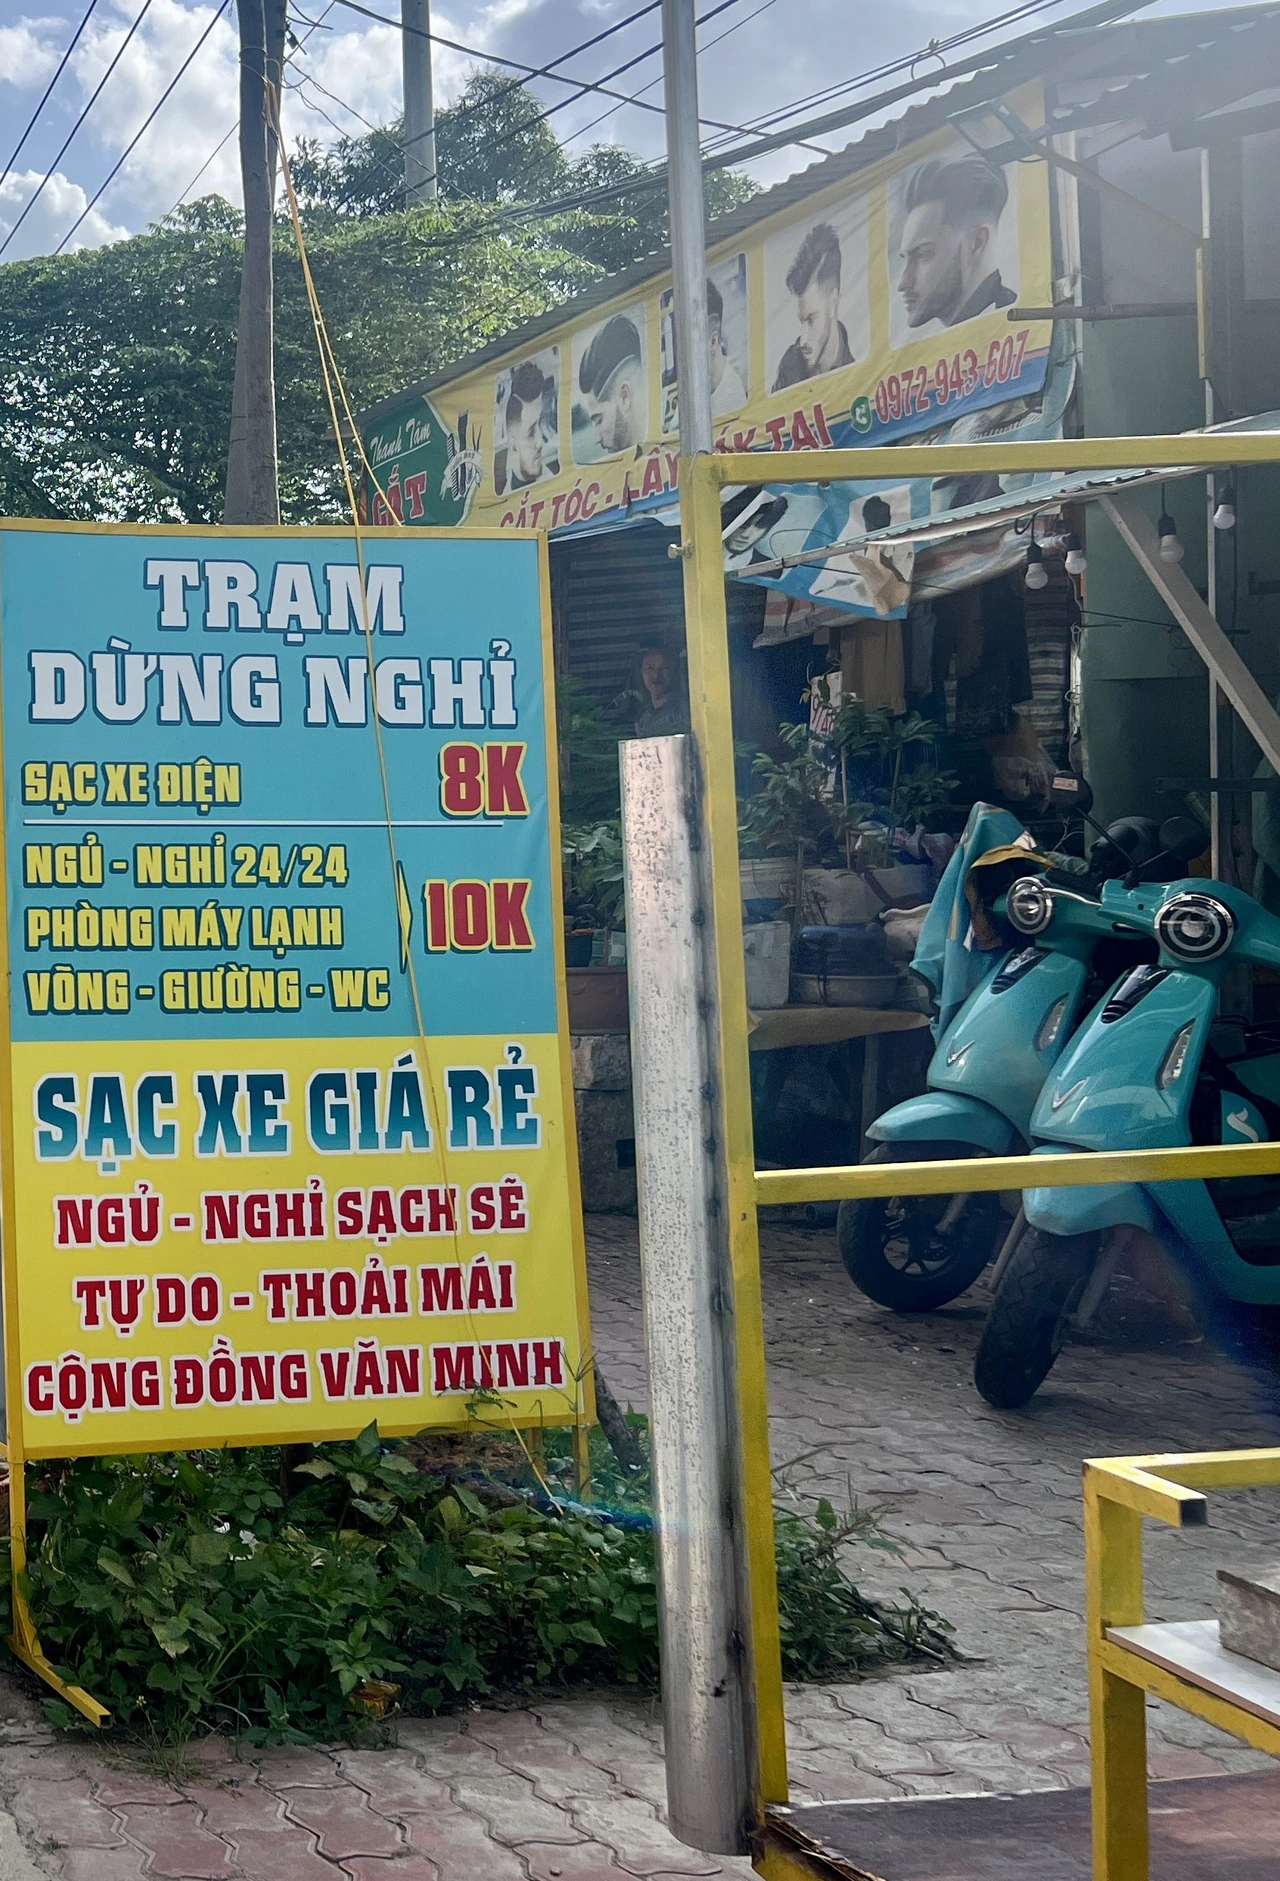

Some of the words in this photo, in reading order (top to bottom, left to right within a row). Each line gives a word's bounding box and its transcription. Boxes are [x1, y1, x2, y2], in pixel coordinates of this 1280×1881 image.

[875, 365, 930, 424] 0972
[934, 348, 978, 405] 943
[983, 328, 1030, 388] 607
[370, 426, 402, 467] Thanh
[405, 417, 431, 449] Tâm
[551, 478, 600, 528] TÓC
[765, 403, 833, 451] TAI
[145, 558, 406, 644] TRẠM
[28, 637, 283, 726] DỪNG
[304, 639, 519, 727] NGHỈ
[22, 760, 99, 814] SẠC
[102, 761, 148, 804] XE
[157, 756, 242, 814] ĐIỆN
[439, 741, 530, 817] 8K
[23, 834, 104, 887] NGỦ
[134, 834, 227, 887] NGHỈ
[232, 843, 349, 886] 24/24
[25, 901, 154, 951] PHÒNG
[160, 900, 245, 950] MÁY
[251, 906, 345, 957] LẠNH
[424, 879, 536, 954] 10K
[25, 965, 130, 1014] VÕNG
[163, 967, 302, 1013] GIƯỜNG
[330, 968, 390, 1011] WC
[34, 1070, 179, 1175] SẠC
[194, 1068, 291, 1157] XE
[306, 1049, 433, 1155] GIÁ
[444, 1042, 541, 1151] RẺ
[54, 1179, 160, 1249] NGỦ
[202, 1175, 327, 1243] NGHỈ
[337, 1184, 458, 1246] SẠCH
[467, 1176, 529, 1234] SẼ
[74, 1275, 147, 1337] TỰ
[153, 1271, 221, 1327] DO
[260, 1253, 411, 1322] THOẢI
[418, 1253, 517, 1315] MÁI
[25, 1350, 161, 1423] CỘNG
[172, 1334, 309, 1408] ĐỒNG
[320, 1336, 422, 1400] VĂN
[431, 1336, 566, 1394] MINH
